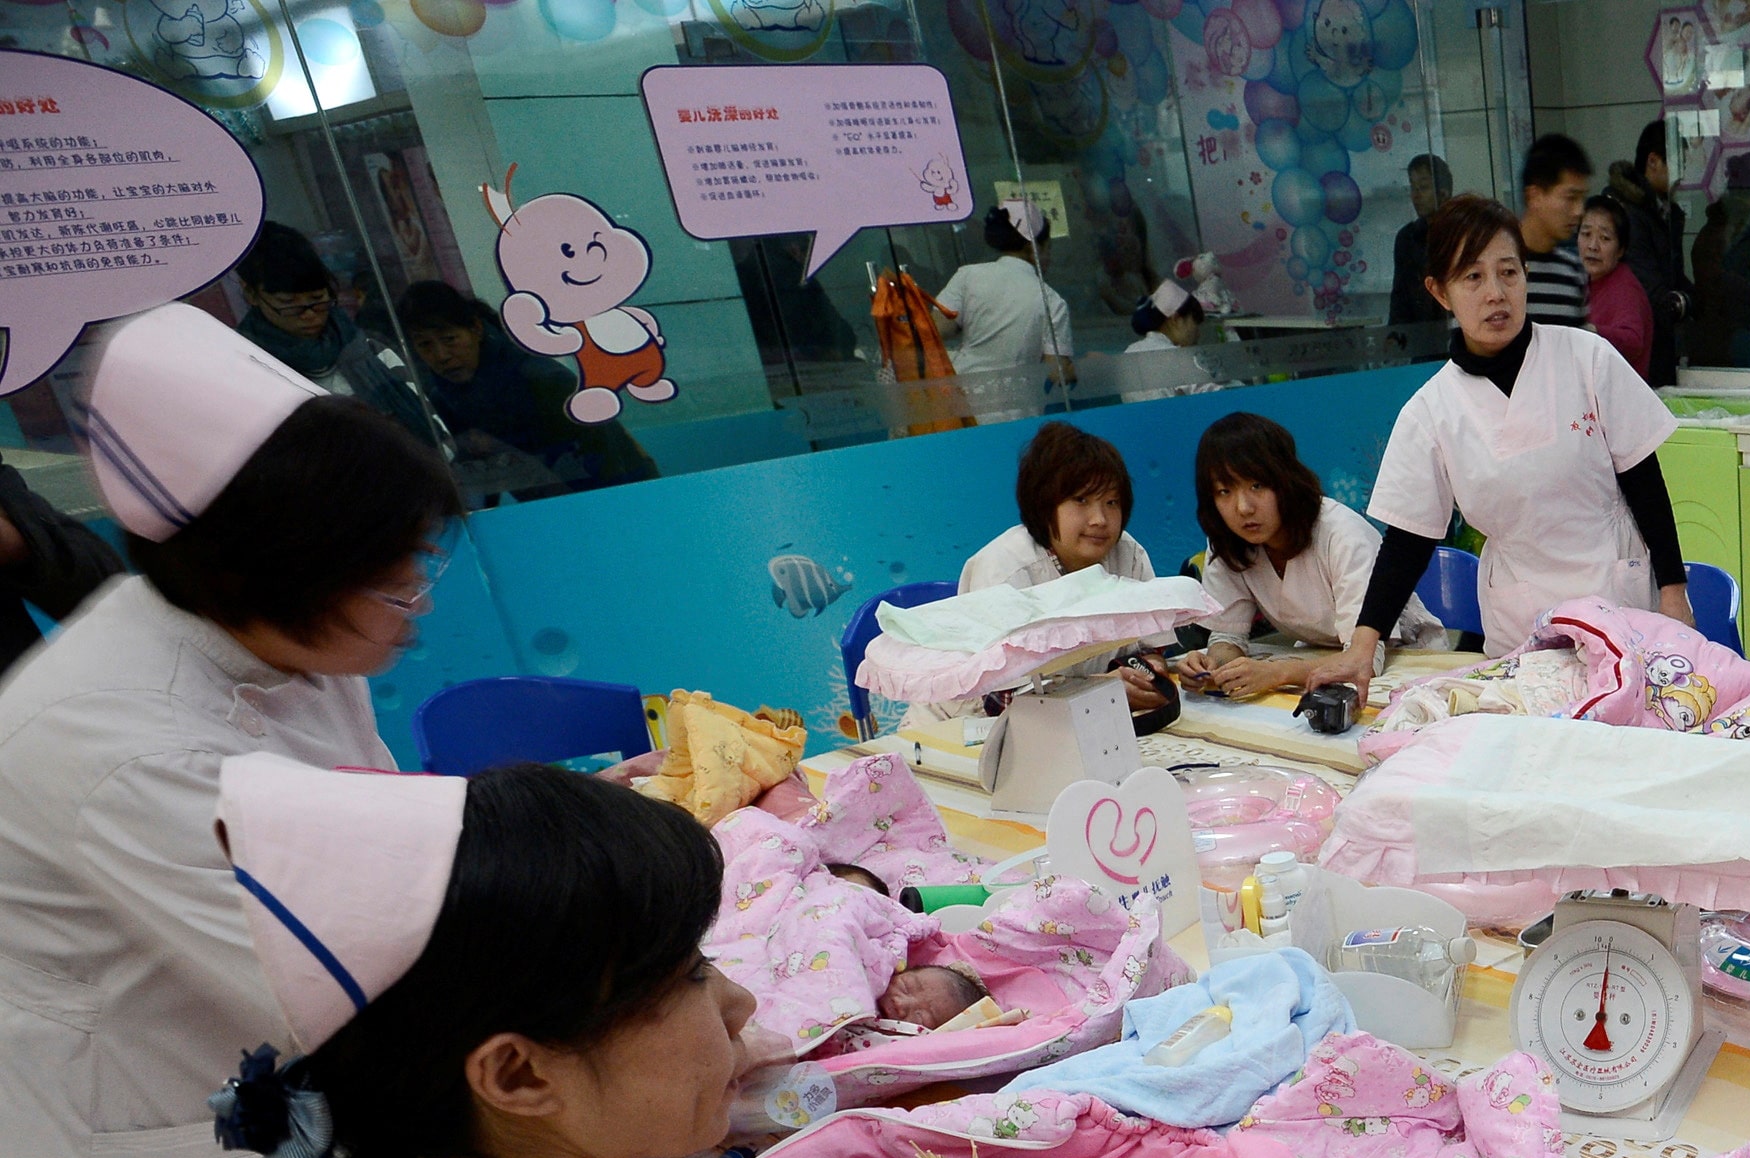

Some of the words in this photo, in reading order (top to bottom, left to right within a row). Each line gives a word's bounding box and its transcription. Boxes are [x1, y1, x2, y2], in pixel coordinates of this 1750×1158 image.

[0, 253, 162, 277] 宝耐寒和抗病的免疫能力。
